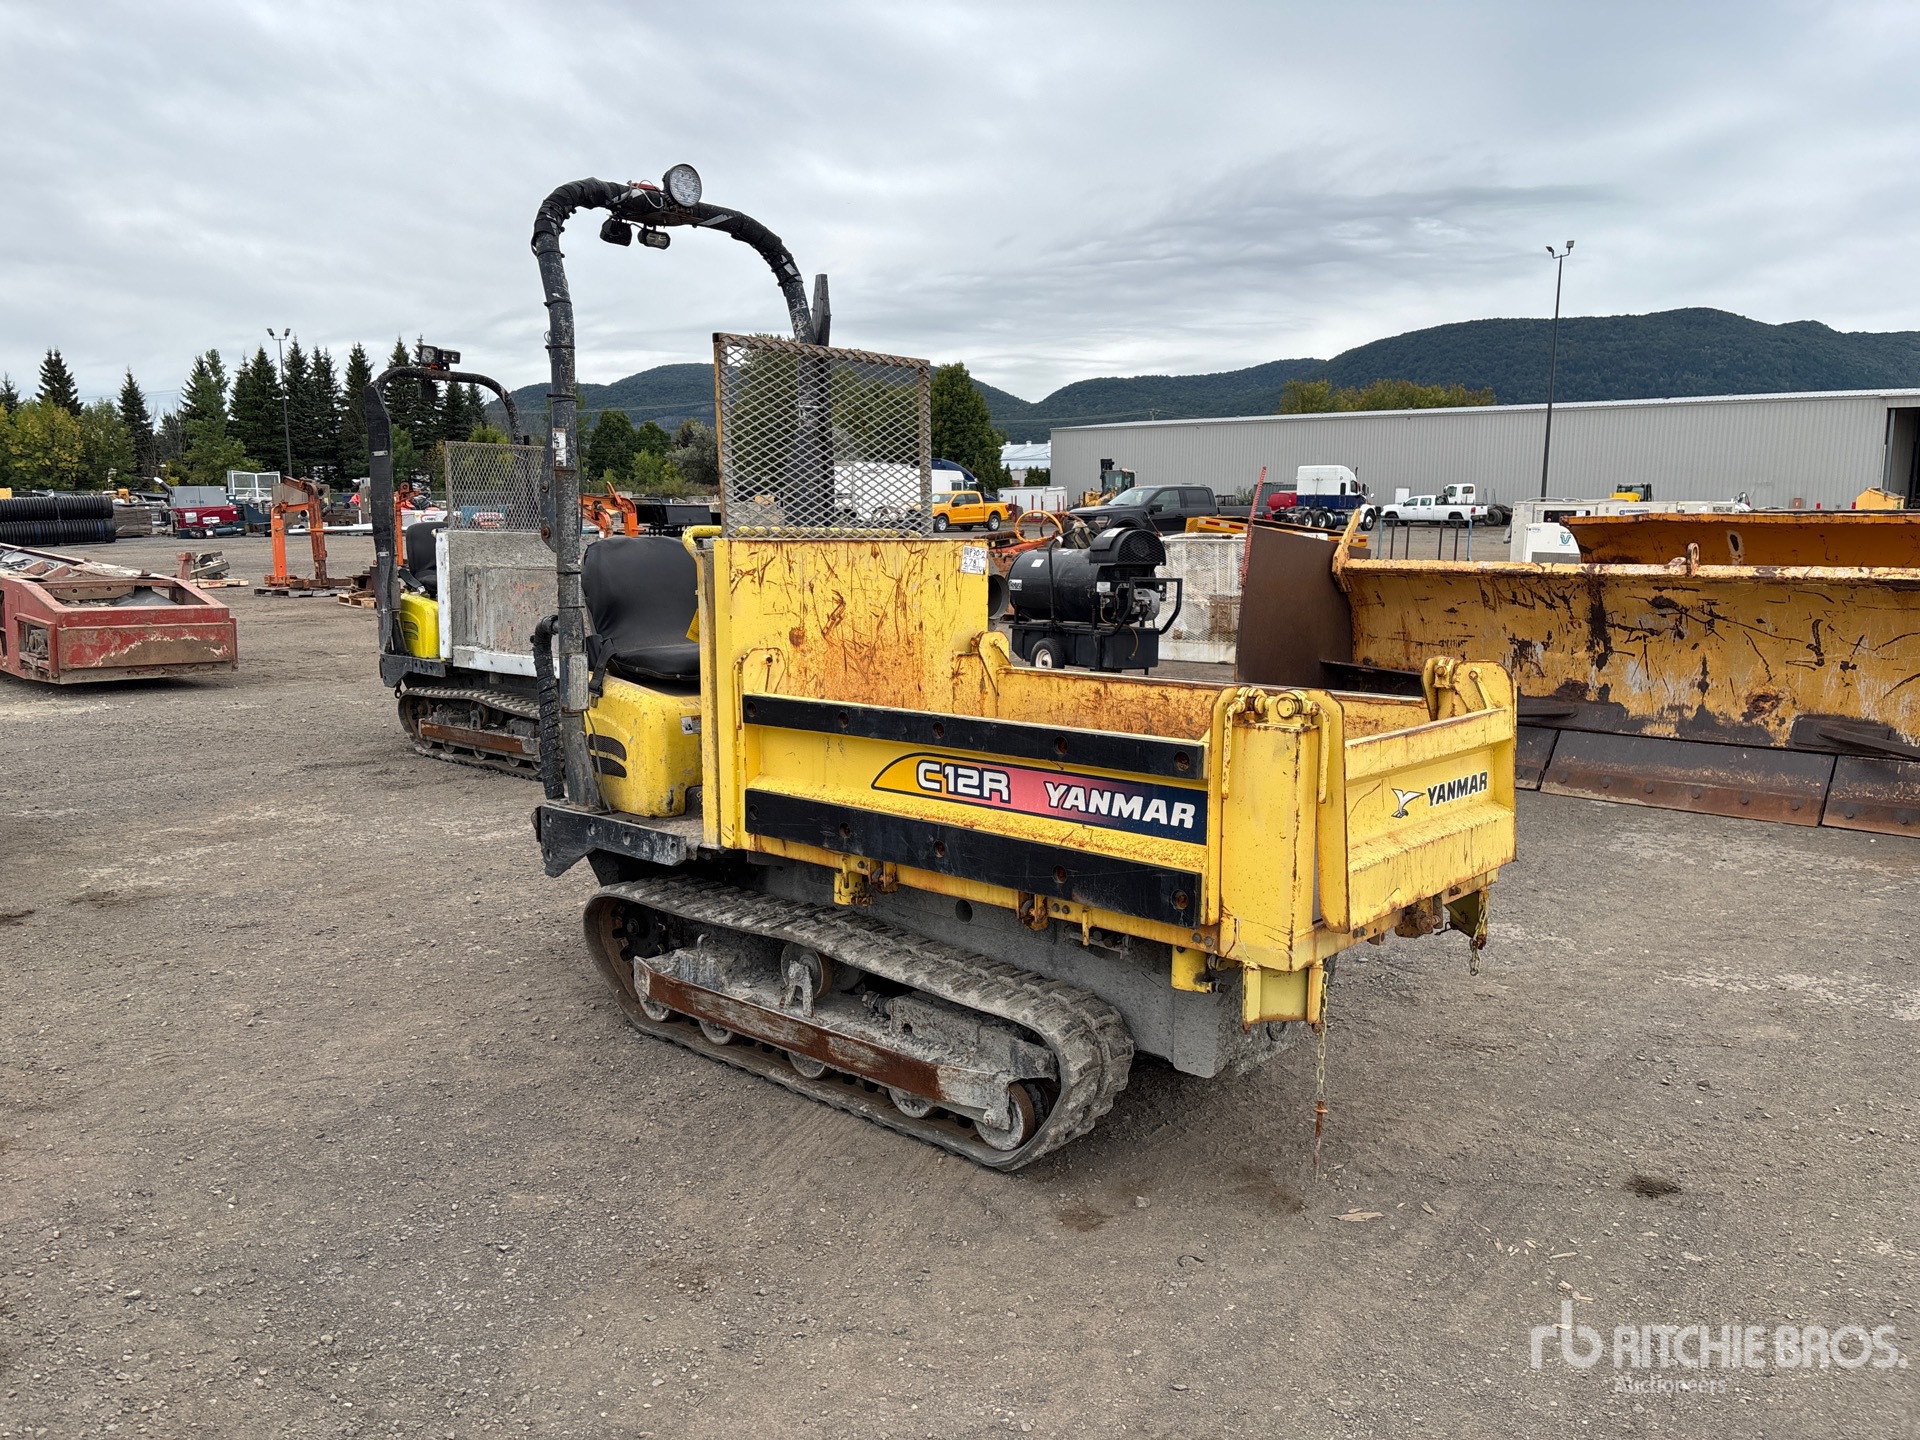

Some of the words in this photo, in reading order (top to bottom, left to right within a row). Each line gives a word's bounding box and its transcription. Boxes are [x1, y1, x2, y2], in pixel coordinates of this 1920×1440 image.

[918, 761, 1010, 802] C12R
[1045, 782, 1197, 829] YANMAR
[1427, 771, 1488, 807] YANMAR
